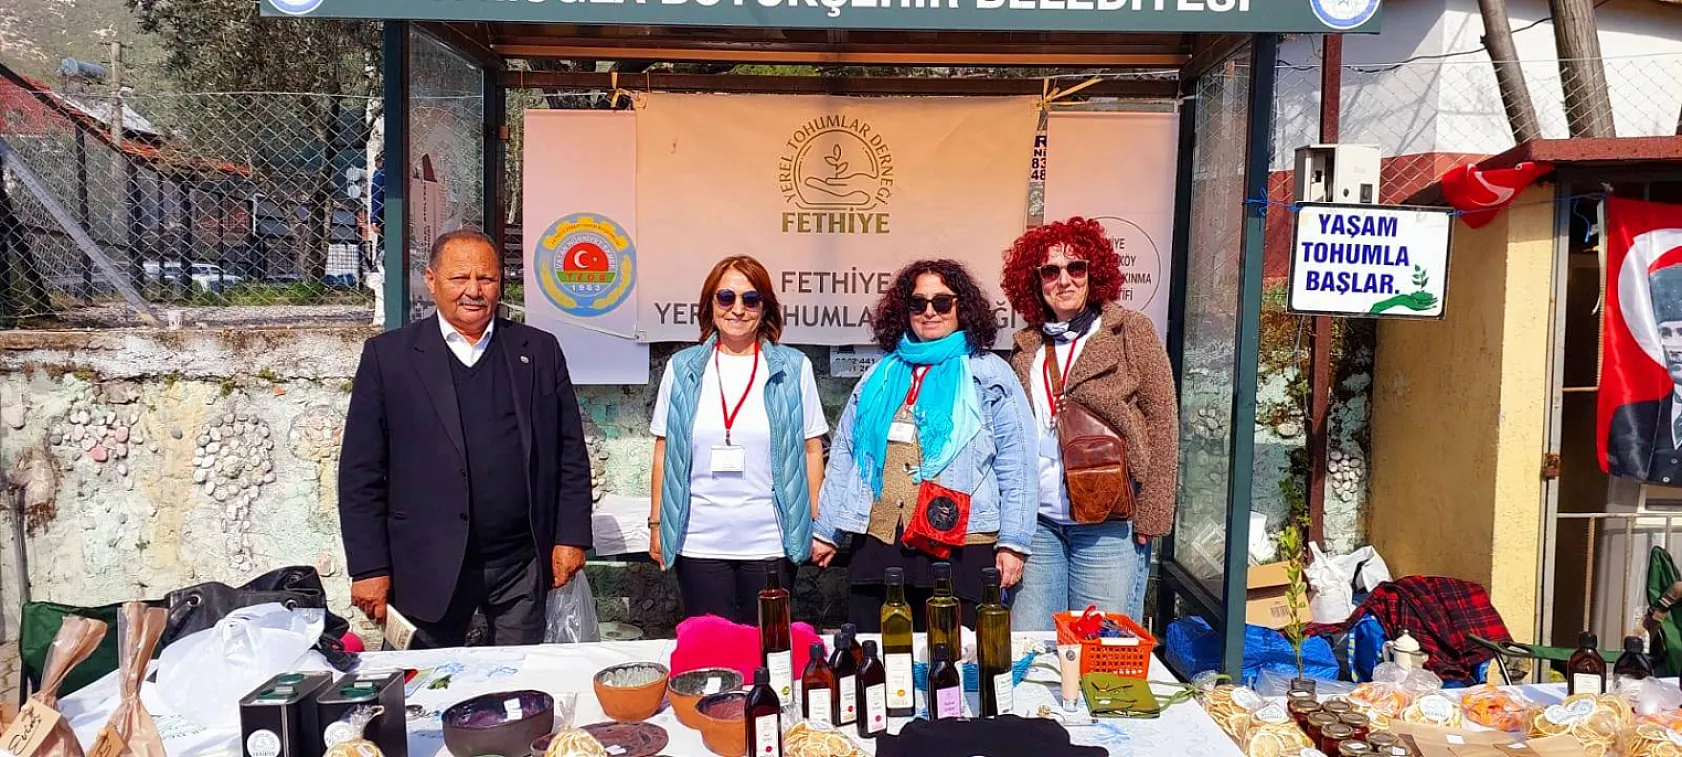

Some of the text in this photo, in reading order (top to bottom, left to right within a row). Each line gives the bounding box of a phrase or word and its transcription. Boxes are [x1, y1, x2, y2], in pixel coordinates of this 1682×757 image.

[779, 115, 894, 205] YEREL TOHUMLAR DERNEĞİ
[781, 207, 890, 234] FETHİYE
[1318, 213, 1398, 238] YAŞAM
[1301, 242, 1410, 266] TOHUMLA
[571, 283, 600, 292] 1963
[781, 266, 891, 294] FETHİYE
[1305, 270, 1400, 295] BAŞLAR.
